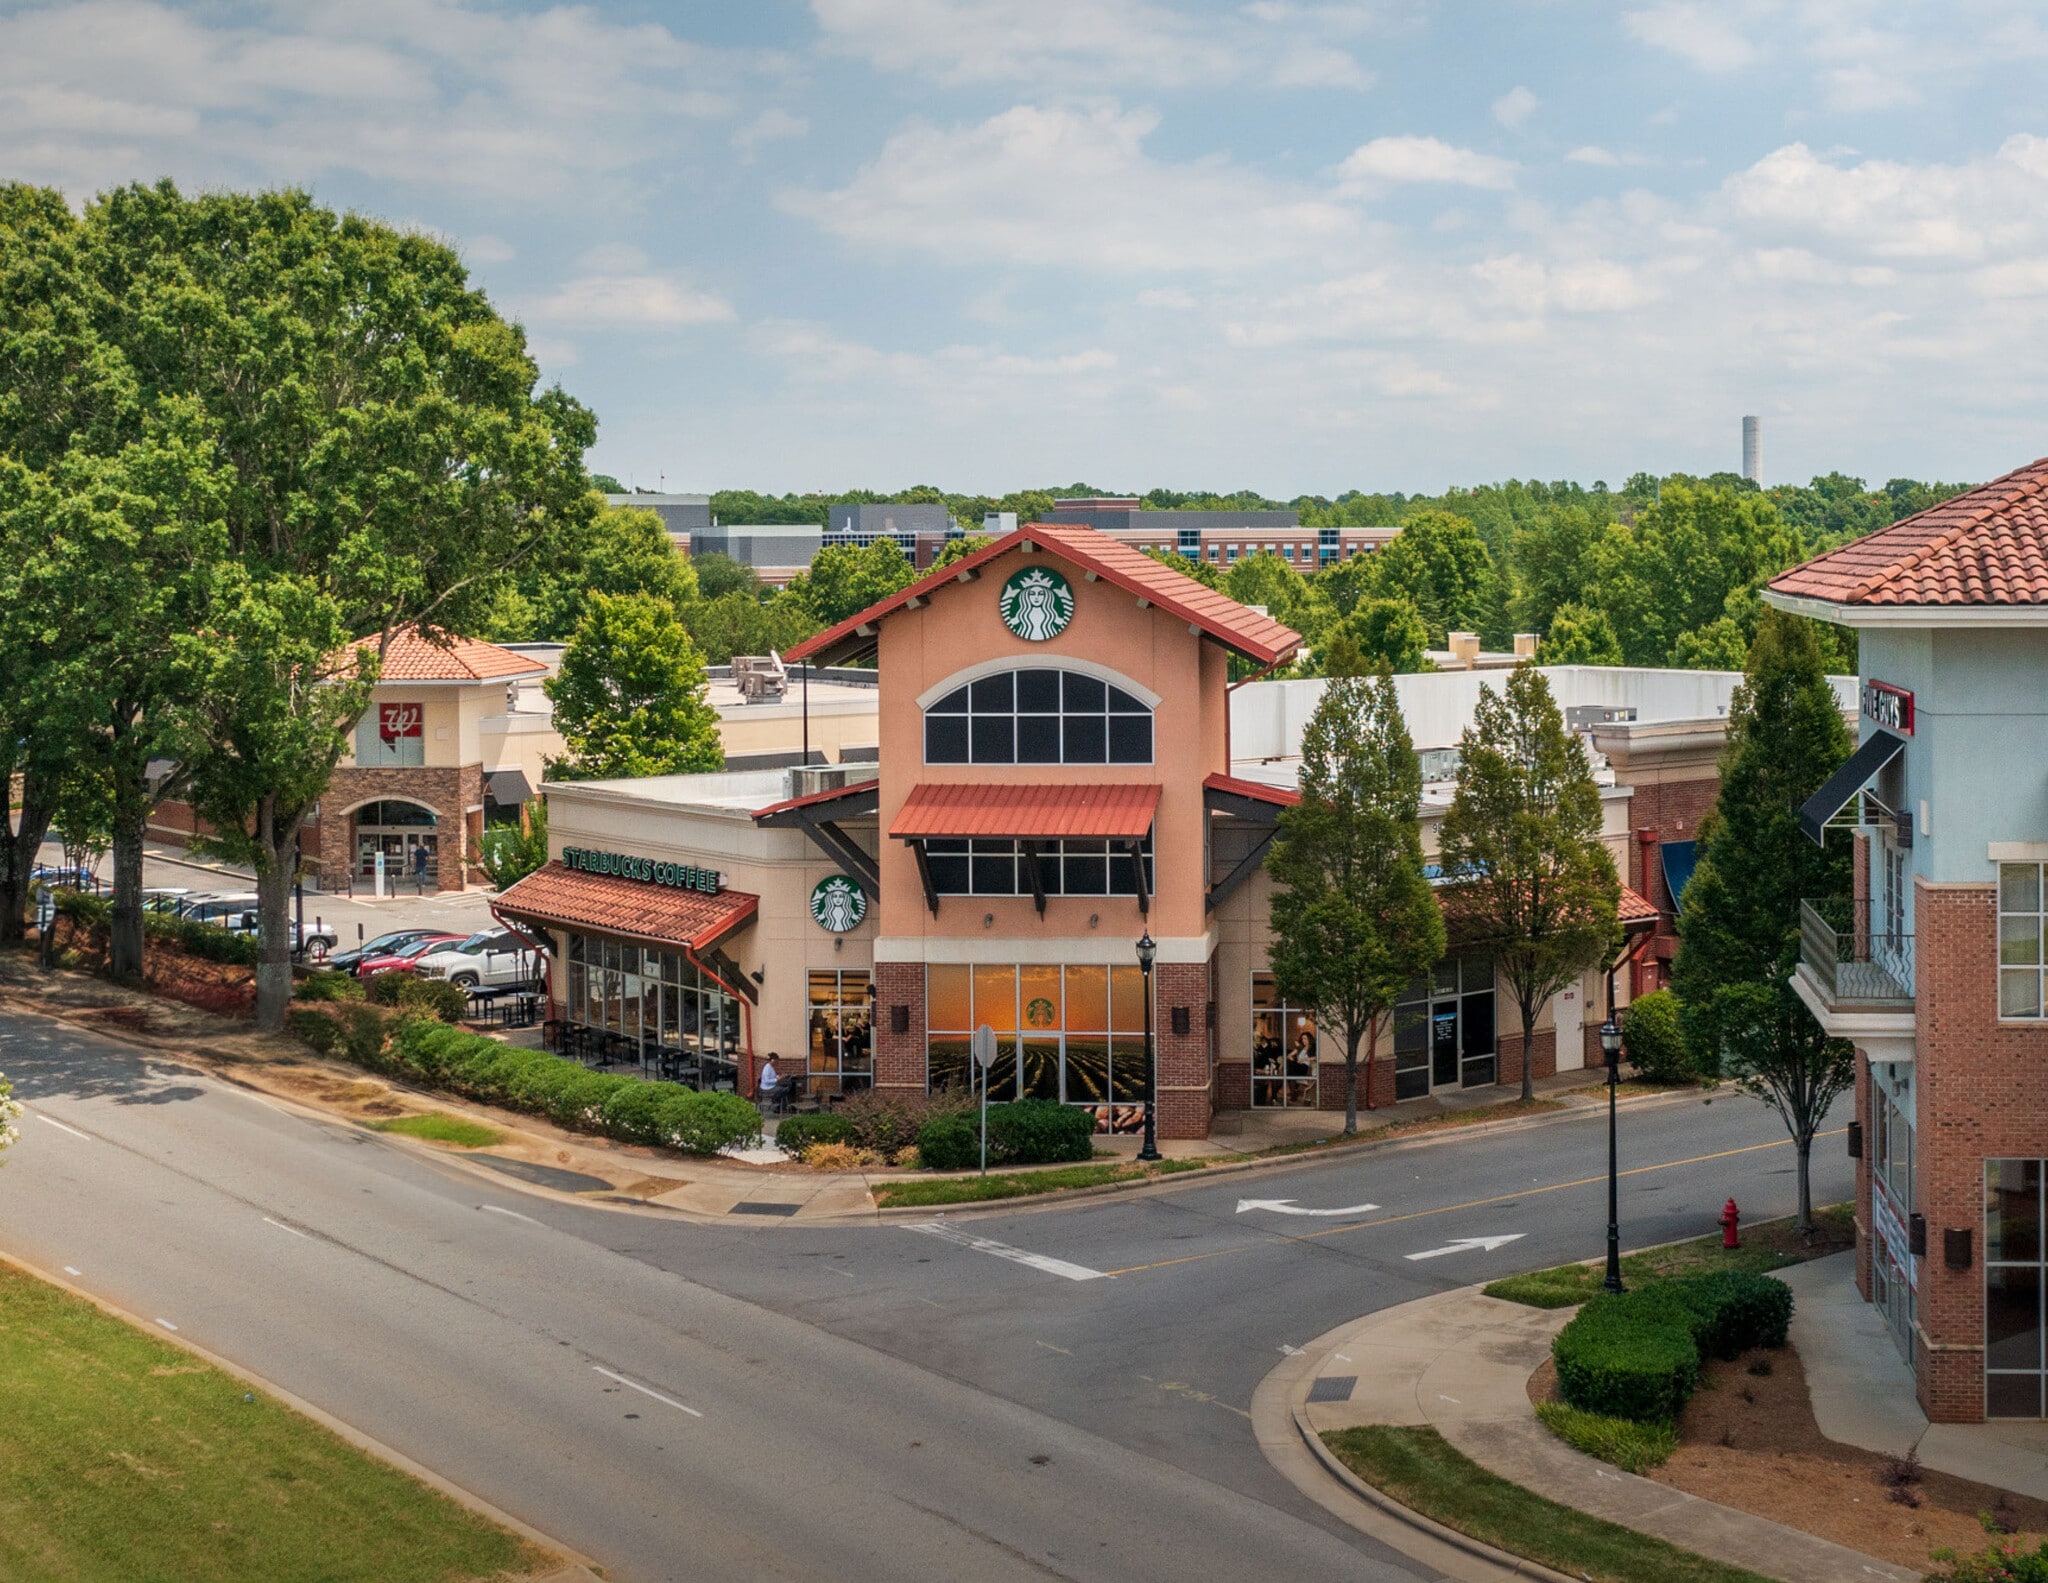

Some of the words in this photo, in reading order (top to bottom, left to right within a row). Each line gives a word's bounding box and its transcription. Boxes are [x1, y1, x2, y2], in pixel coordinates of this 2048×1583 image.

[1879, 690, 1900, 729] GUYS
[562, 846, 651, 881] STARBUCKS
[654, 860, 717, 893] COFFEE
